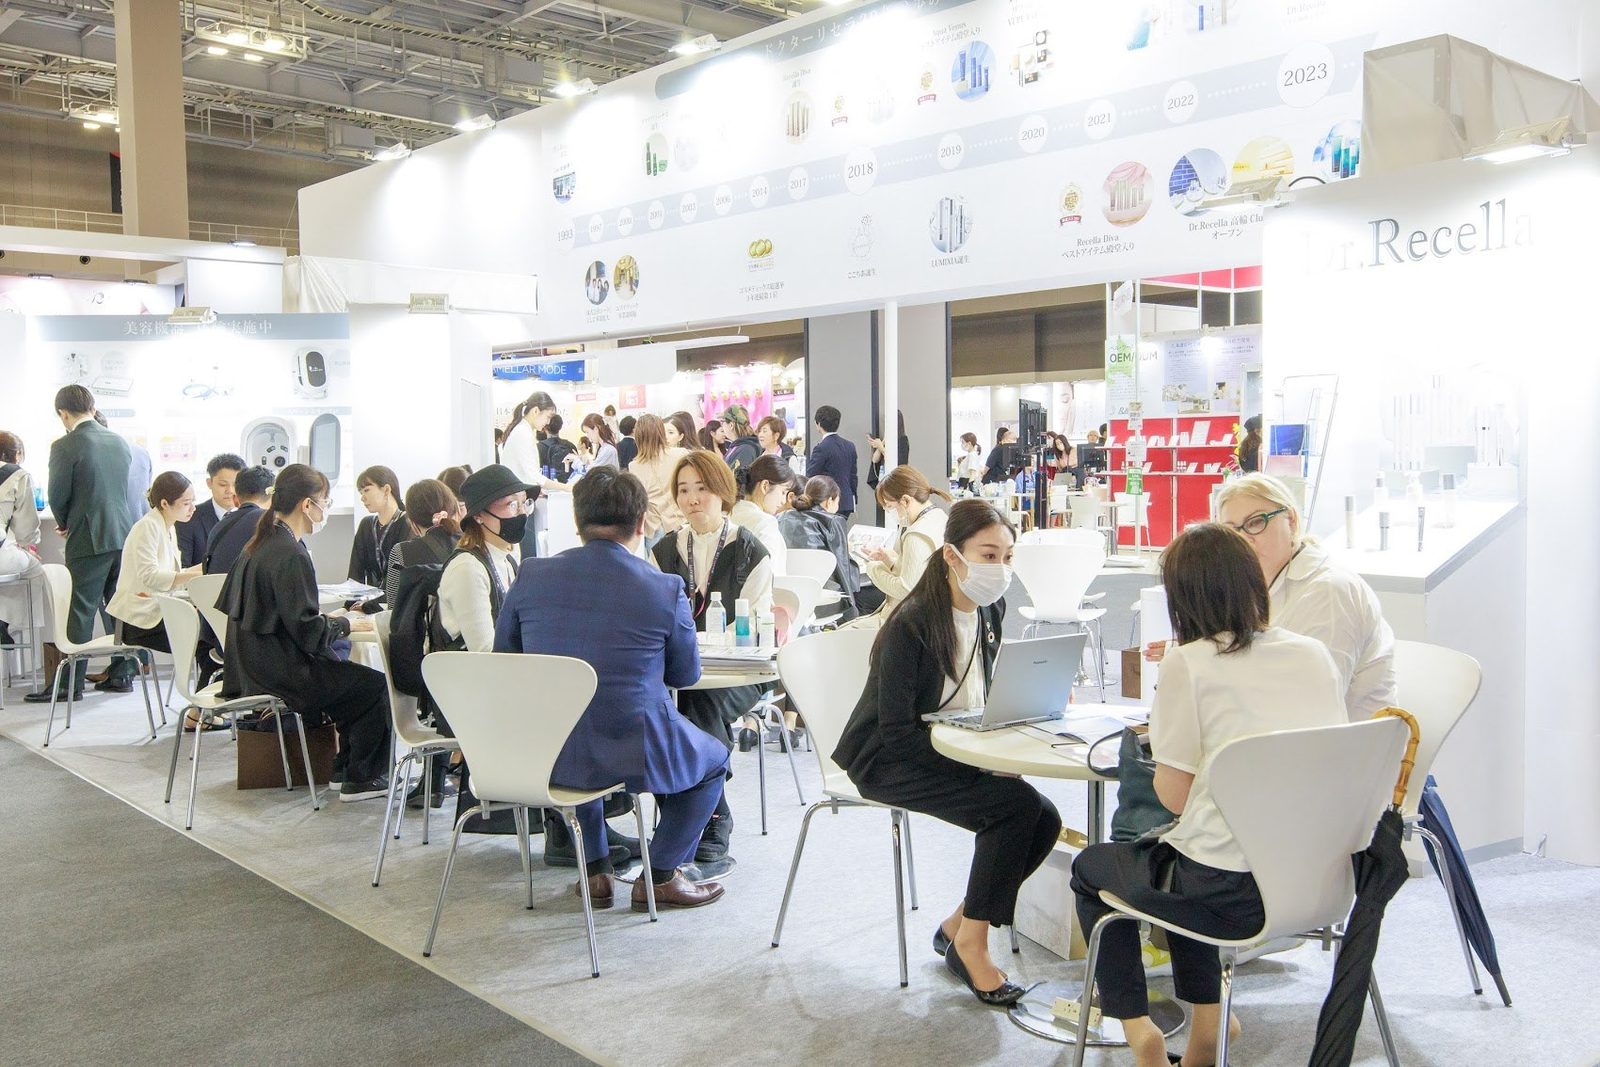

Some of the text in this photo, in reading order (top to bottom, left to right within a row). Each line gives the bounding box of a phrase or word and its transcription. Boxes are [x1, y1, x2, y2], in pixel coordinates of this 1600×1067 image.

[1283, 62, 1328, 87] 2023
[1167, 93, 1194, 111] 2022
[1087, 113, 1112, 128] 2021
[1021, 126, 1045, 142] 2020
[939, 143, 962, 158] 2019
[847, 162, 875, 179] 2018
[789, 177, 807, 191] 2017
[751, 186, 768, 199] 2014
[1188, 218, 1228, 232] Dr.Recella
[557, 229, 574, 242] 1993
[1077, 234, 1119, 247] Recella Diva
[538, 364, 567, 375] MODE
